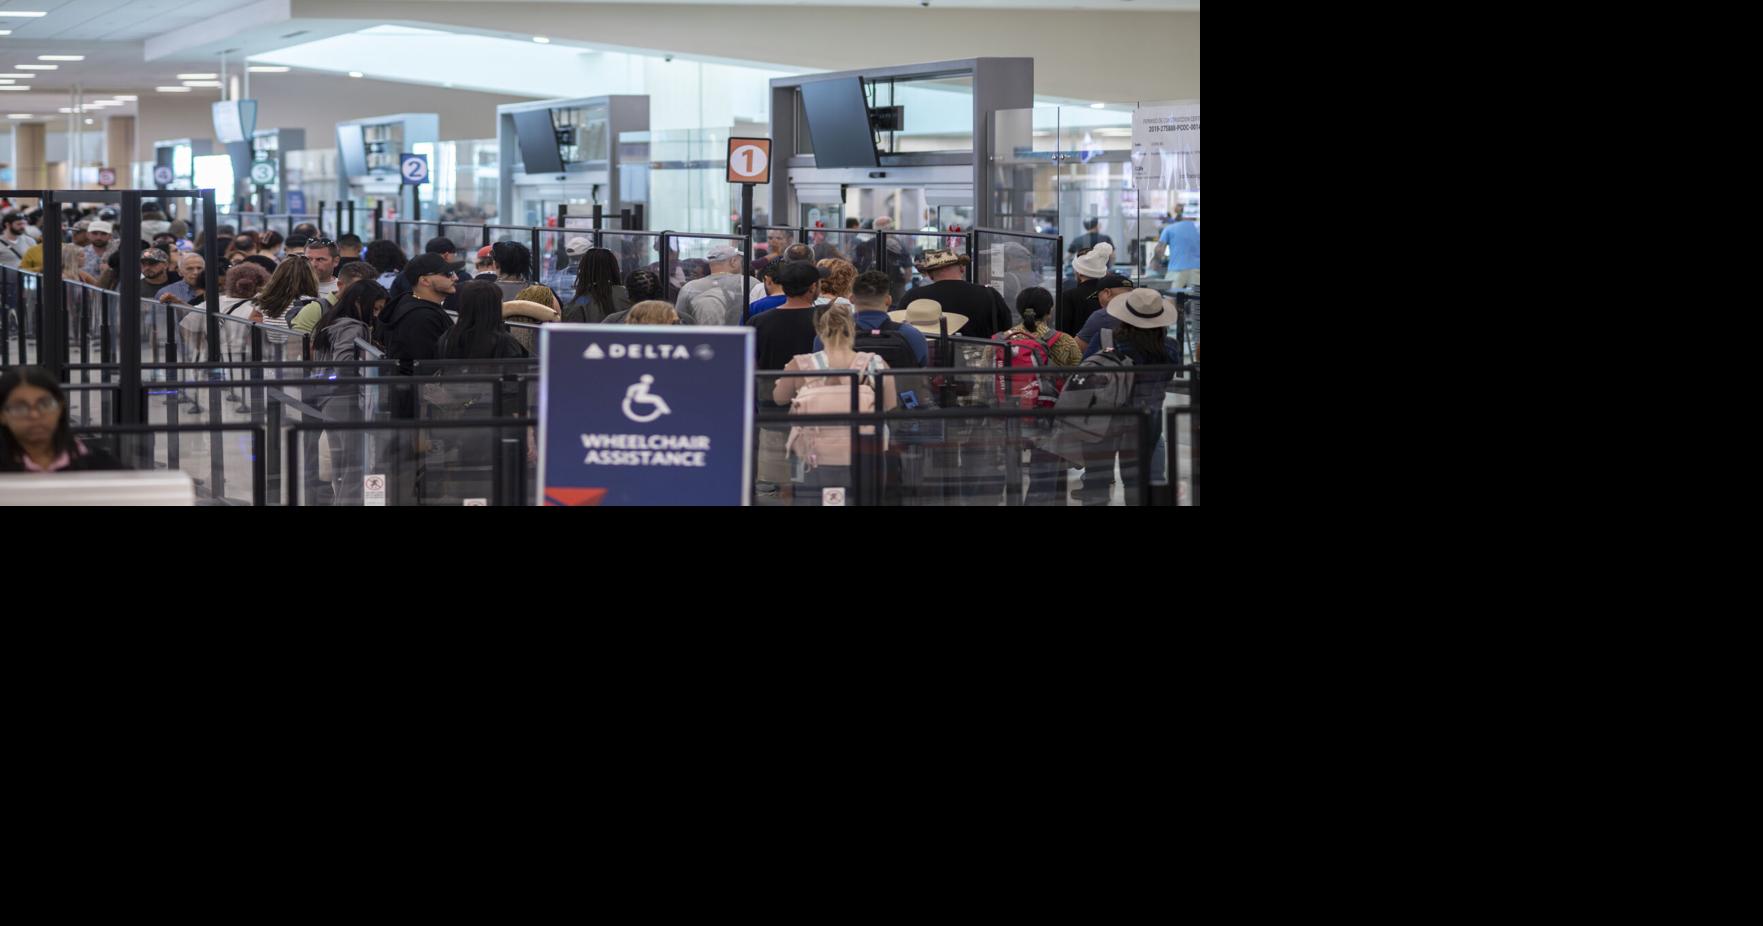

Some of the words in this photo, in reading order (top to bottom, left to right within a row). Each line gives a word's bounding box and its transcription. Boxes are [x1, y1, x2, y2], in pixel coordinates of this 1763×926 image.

[408, 160, 422, 178] 2
[742, 149, 753, 173] 1
[256, 166, 268, 180] 3
[608, 343, 690, 359] DELTA
[580, 433, 711, 450] WHEELCHAIR
[584, 450, 706, 467] ASSISTANCE
